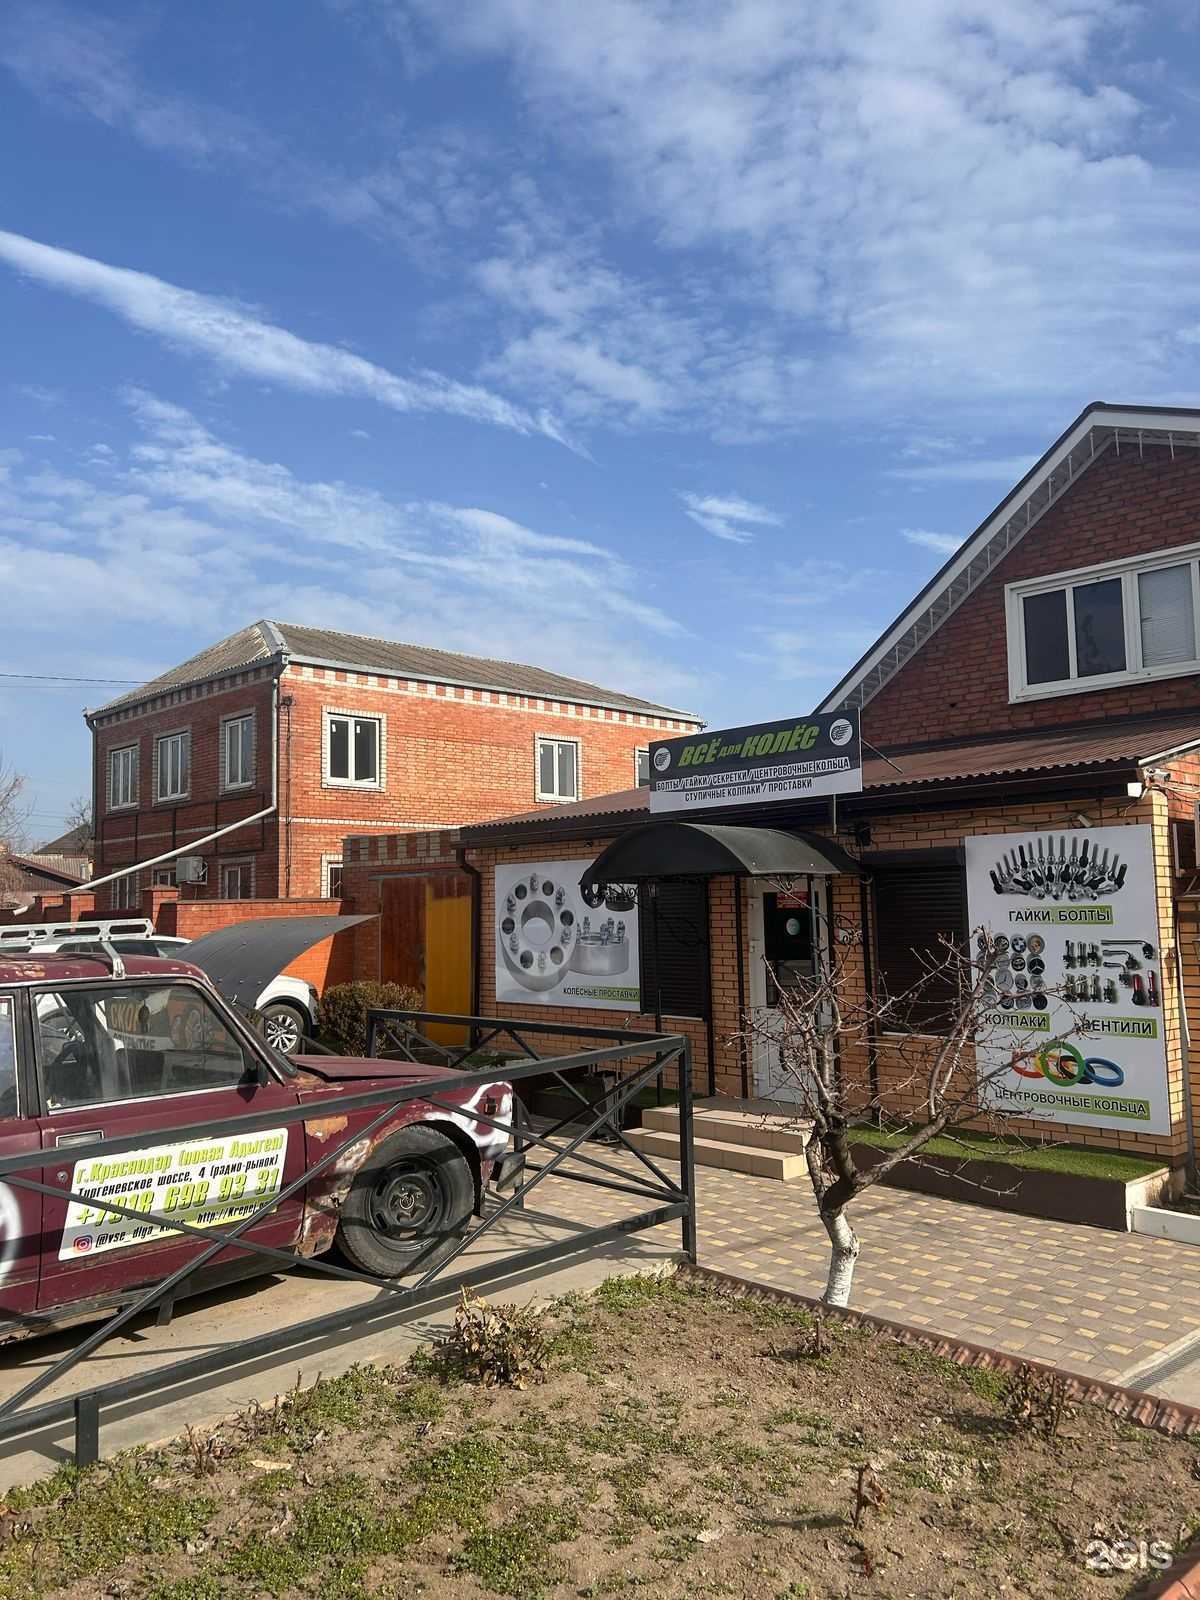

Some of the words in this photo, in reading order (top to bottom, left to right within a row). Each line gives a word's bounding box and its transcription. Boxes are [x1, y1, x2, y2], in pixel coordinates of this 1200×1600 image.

[678, 737, 721, 767] ВСЁ
[720, 743, 742, 759] для
[740, 725, 821, 758] КОЛЁС
[754, 761, 815, 779] ЦЕНТРОВОЧНЫЕ
[815, 757, 850, 771] КОЛЬЦА
[685, 788, 726, 802] СТУПИЧНЫЕ
[727, 784, 761, 798] КОЛПАКИ
[768, 778, 812, 793] ПРОСТАВКИ
[1008, 907, 1055, 922] ГАЙКИ,
[1058, 909, 1110, 921] БОЛТЫ
[984, 1013, 1046, 1028] КОЛПАКИ
[1094, 1099, 1147, 1115] КОЛЬЦА
[198, 1166, 206, 1179] 4
[164, 1180, 210, 1214] 698
[217, 1173, 247, 1203] 93
[255, 1168, 280, 1195] 31
